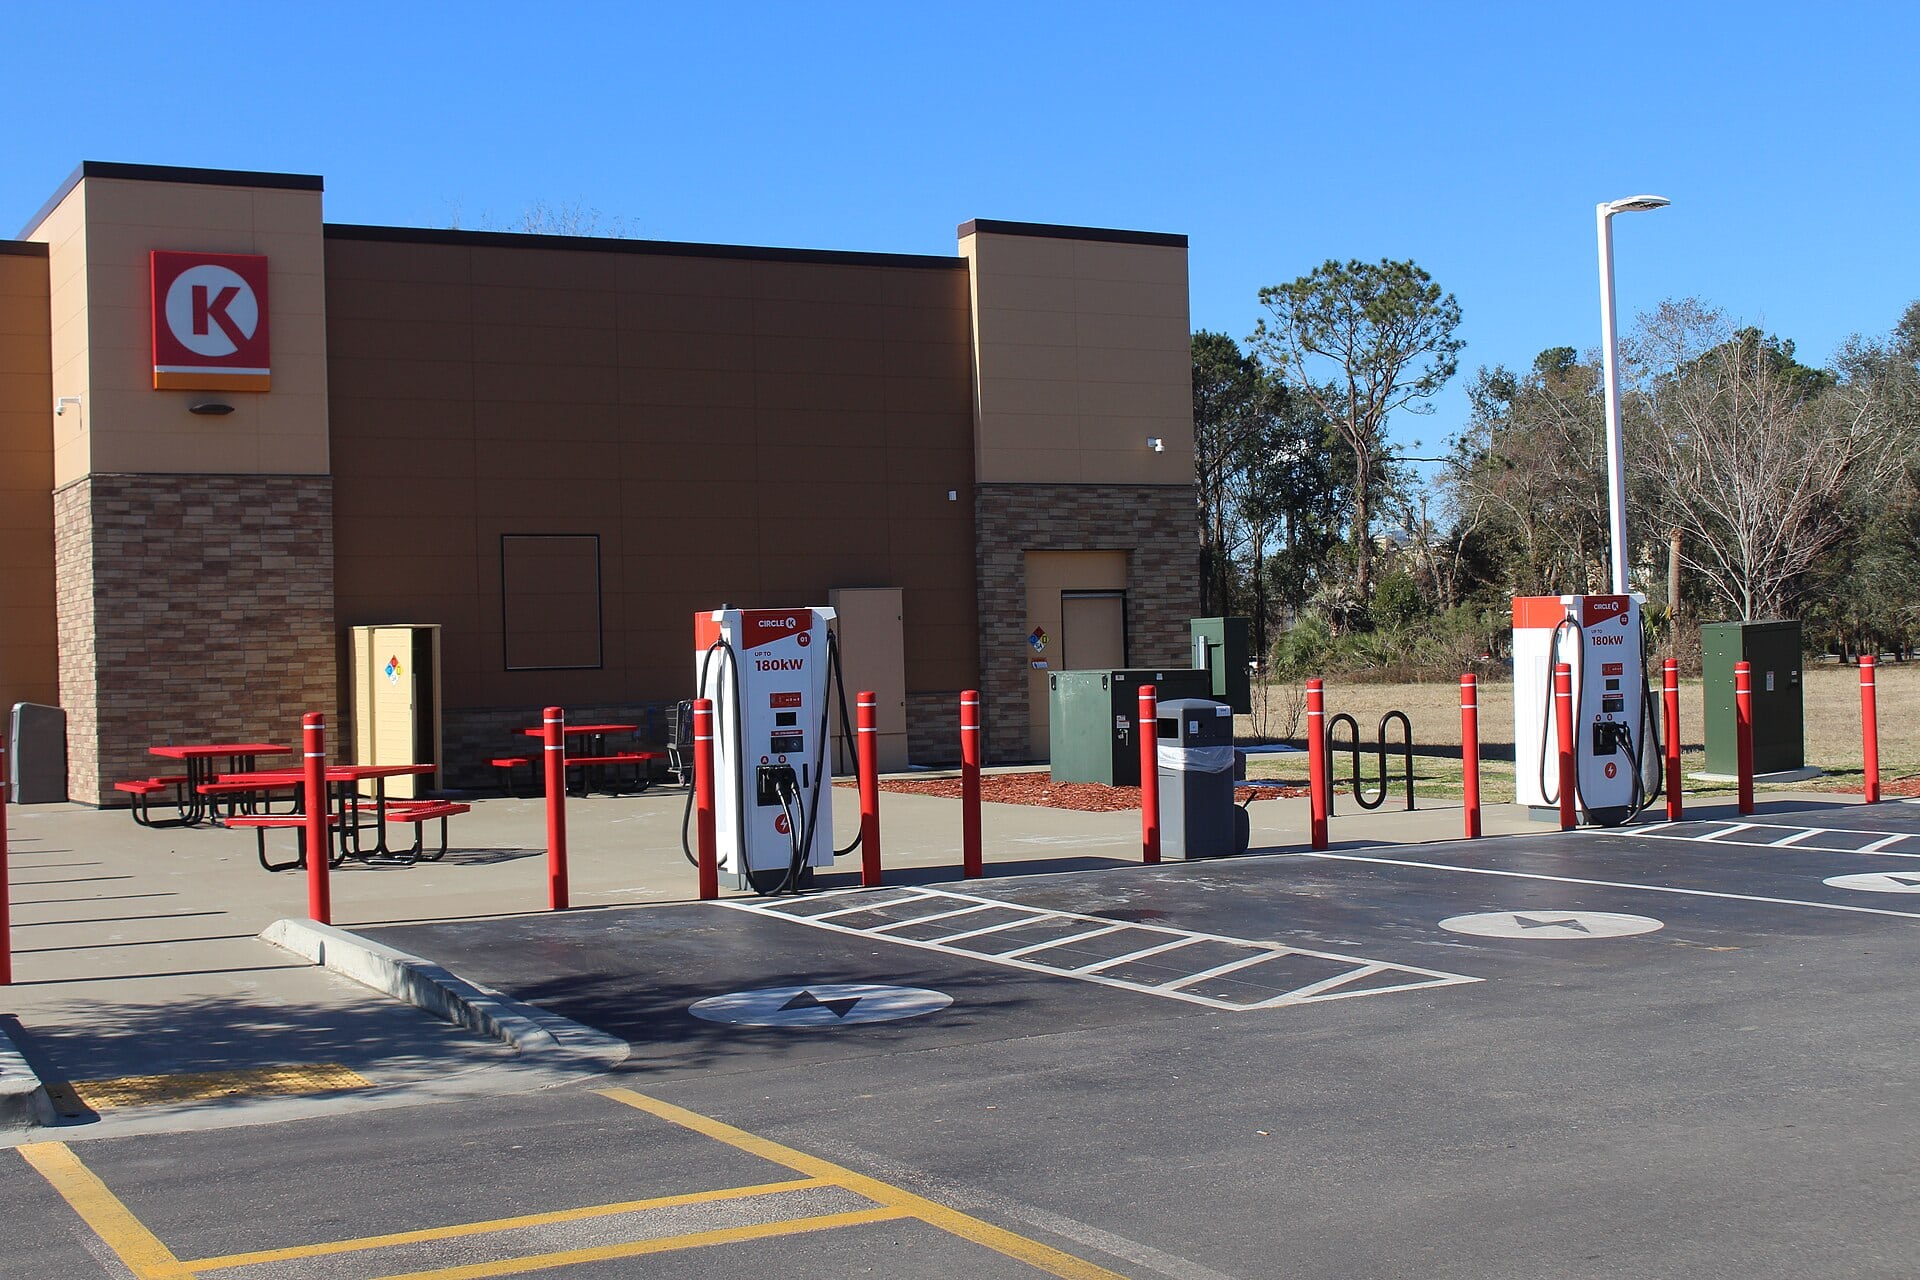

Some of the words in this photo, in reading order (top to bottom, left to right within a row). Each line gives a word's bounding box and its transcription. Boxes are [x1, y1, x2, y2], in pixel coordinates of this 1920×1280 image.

[189, 282, 253, 354] K
[1612, 602, 1619, 611] K
[758, 620, 785, 628] CIRCLE
[786, 617, 796, 629] K
[1591, 635, 1624, 646] 180kW
[755, 658, 804, 672] 180kW
